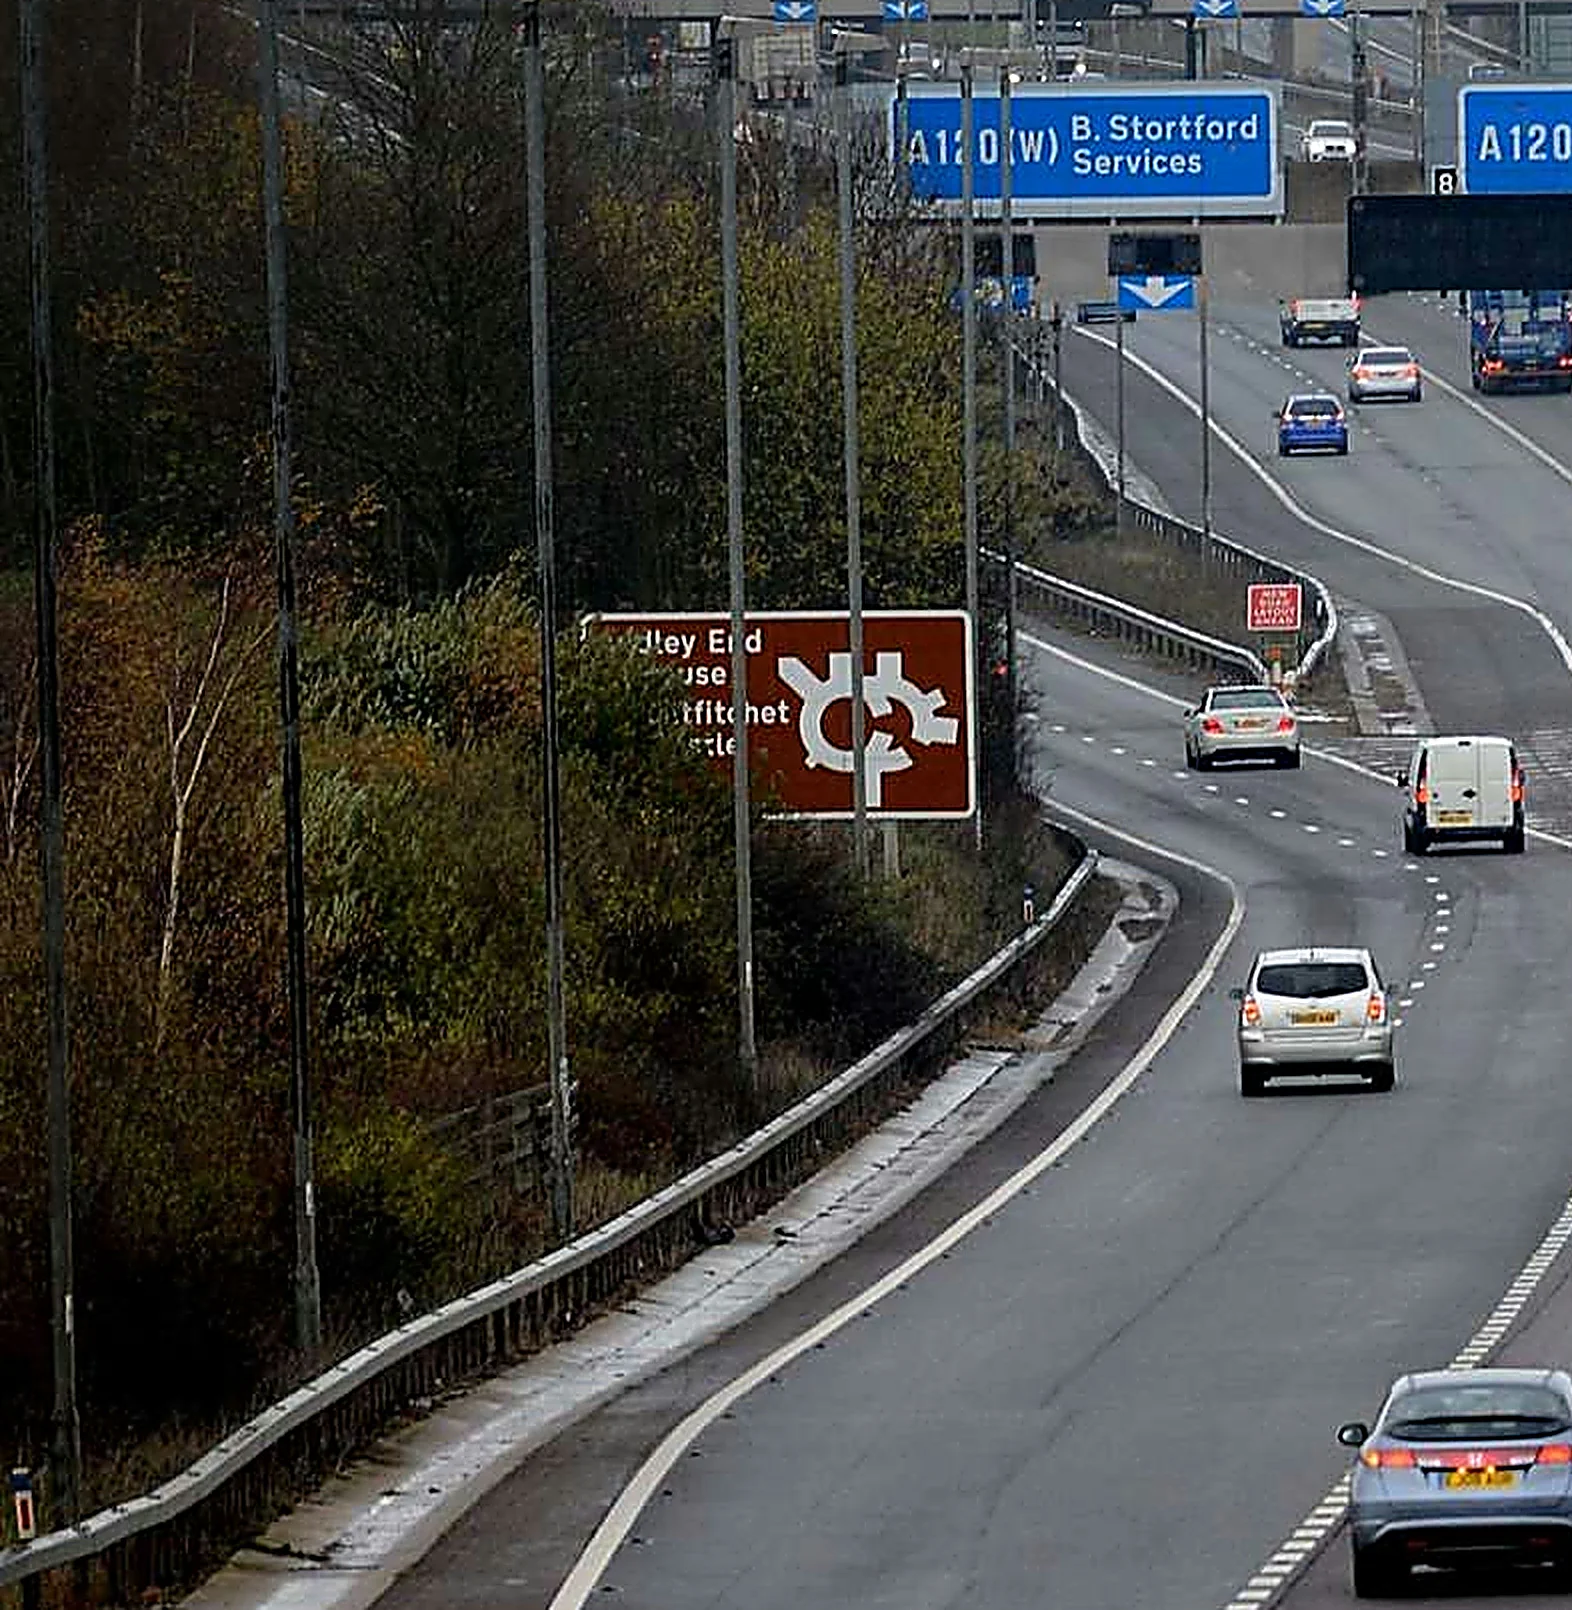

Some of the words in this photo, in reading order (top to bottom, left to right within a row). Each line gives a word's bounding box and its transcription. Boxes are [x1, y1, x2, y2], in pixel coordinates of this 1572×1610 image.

[1072, 115, 1100, 141] B.
[1110, 114, 1257, 141] Stortford
[1073, 148, 1203, 175] Services
[1439, 172, 1453, 195] 8
